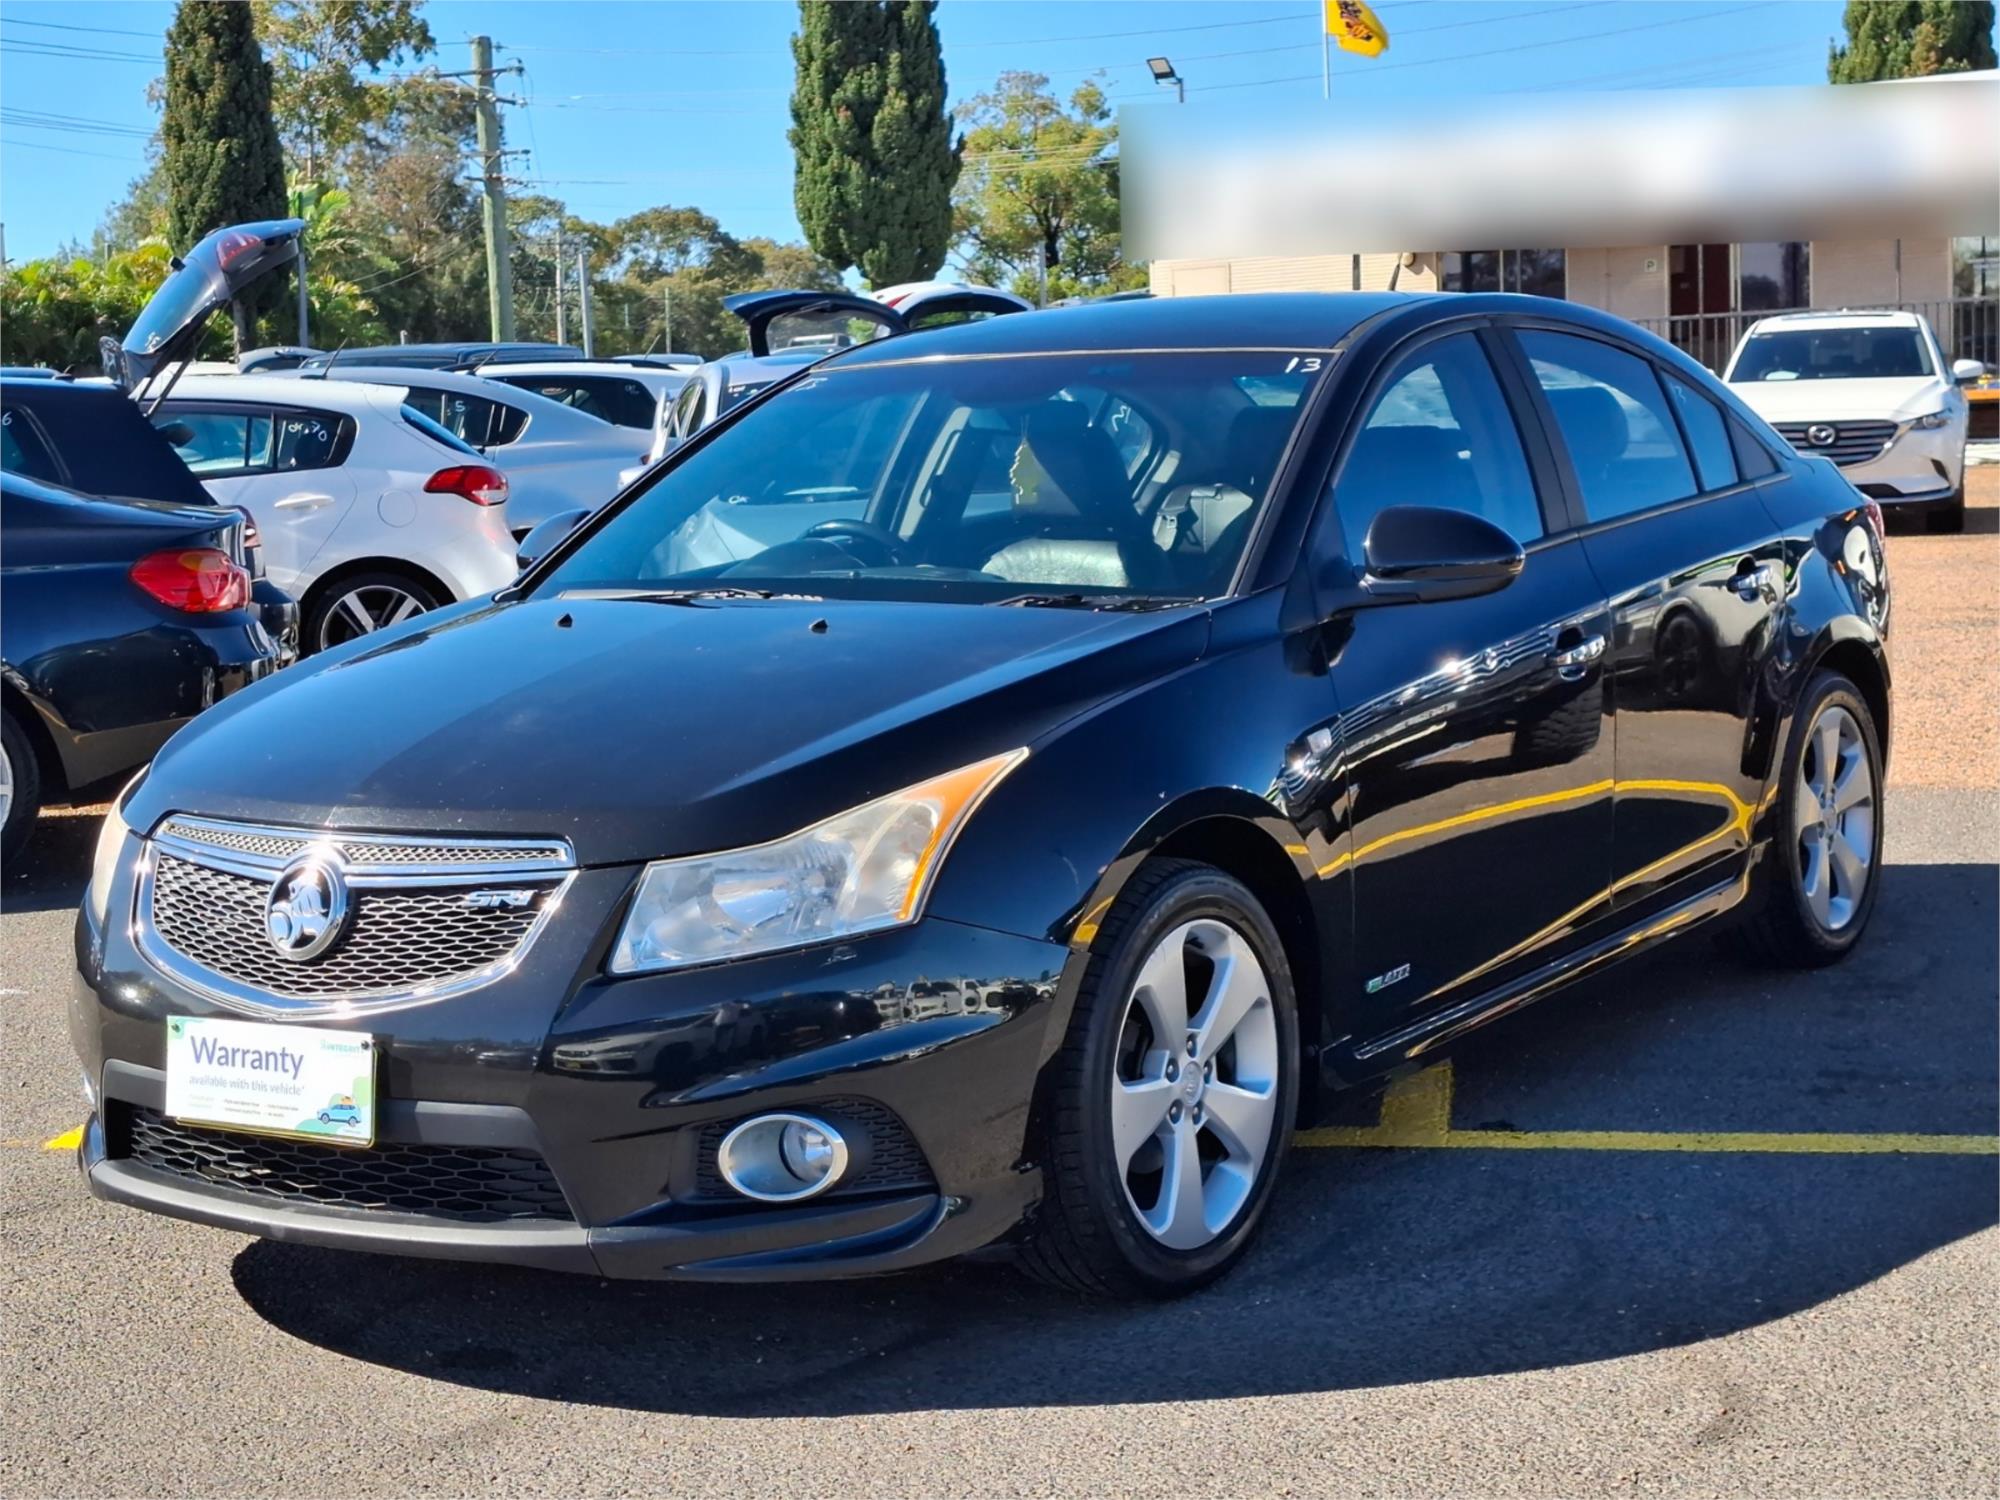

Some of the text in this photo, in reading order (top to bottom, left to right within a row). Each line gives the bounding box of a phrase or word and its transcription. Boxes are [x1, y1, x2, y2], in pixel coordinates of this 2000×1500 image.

[1285, 356, 1321, 374] 13
[190, 1035, 304, 1080] Warranty
[189, 1074, 227, 1088] available
[229, 1078, 250, 1090] with
[251, 1079, 268, 1092] this
